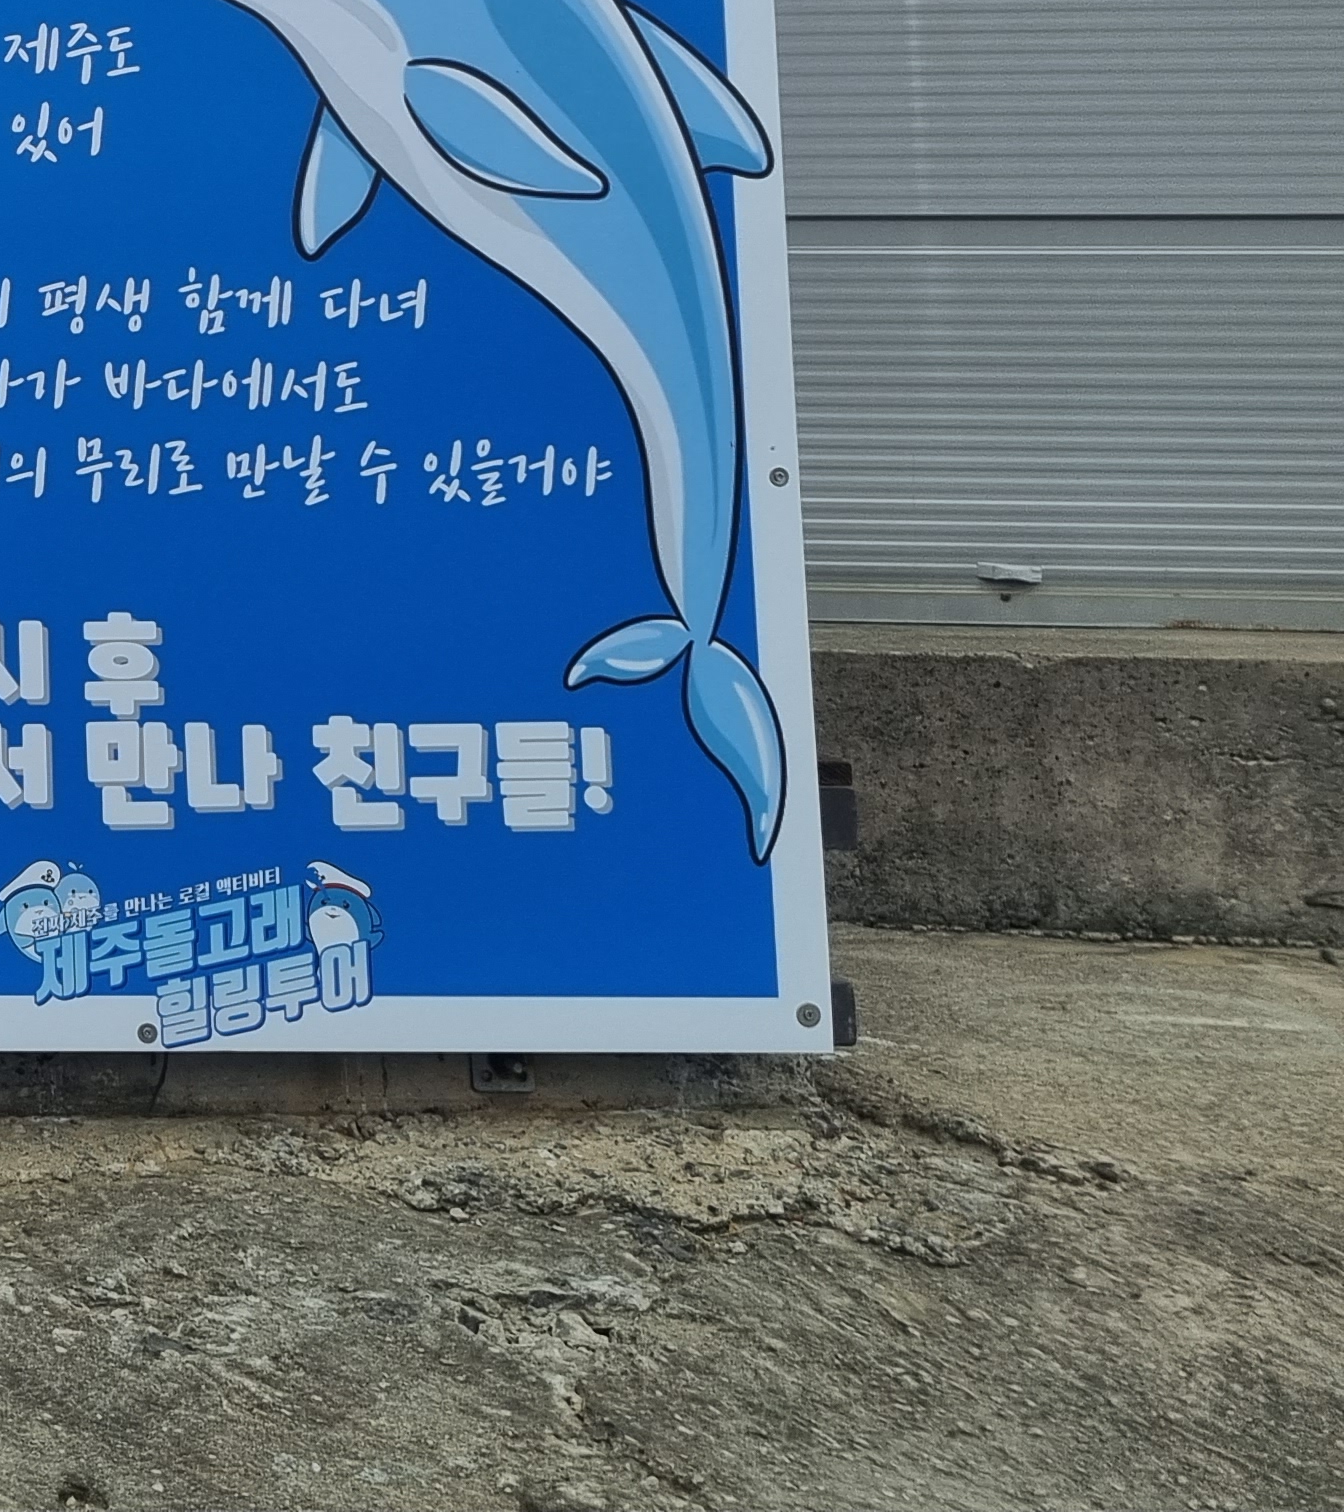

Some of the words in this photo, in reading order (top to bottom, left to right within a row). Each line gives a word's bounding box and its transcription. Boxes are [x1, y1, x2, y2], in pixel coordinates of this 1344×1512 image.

[4, 23, 140, 84] 제주도
[11, 101, 104, 163] 있어
[38, 275, 150, 333] 평생
[179, 267, 292, 335] 함께
[319, 278, 427, 329] 다녀
[105, 357, 368, 413] 바다에서도
[75, 436, 203, 504] 무리로
[226, 434, 336, 506] 만날
[359, 439, 398, 505] 수
[423, 438, 613, 507] 있을거야
[82, 610, 165, 720] 후
[84, 720, 284, 832] 만나
[310, 714, 616, 833] 친구들!
[124, 893, 173, 918] 만나는
[178, 881, 210, 905] 로컬
[216, 866, 281, 896] 액티비티
[34, 884, 306, 1005] 제주돌고래
[156, 939, 373, 1048] 힐링투어
